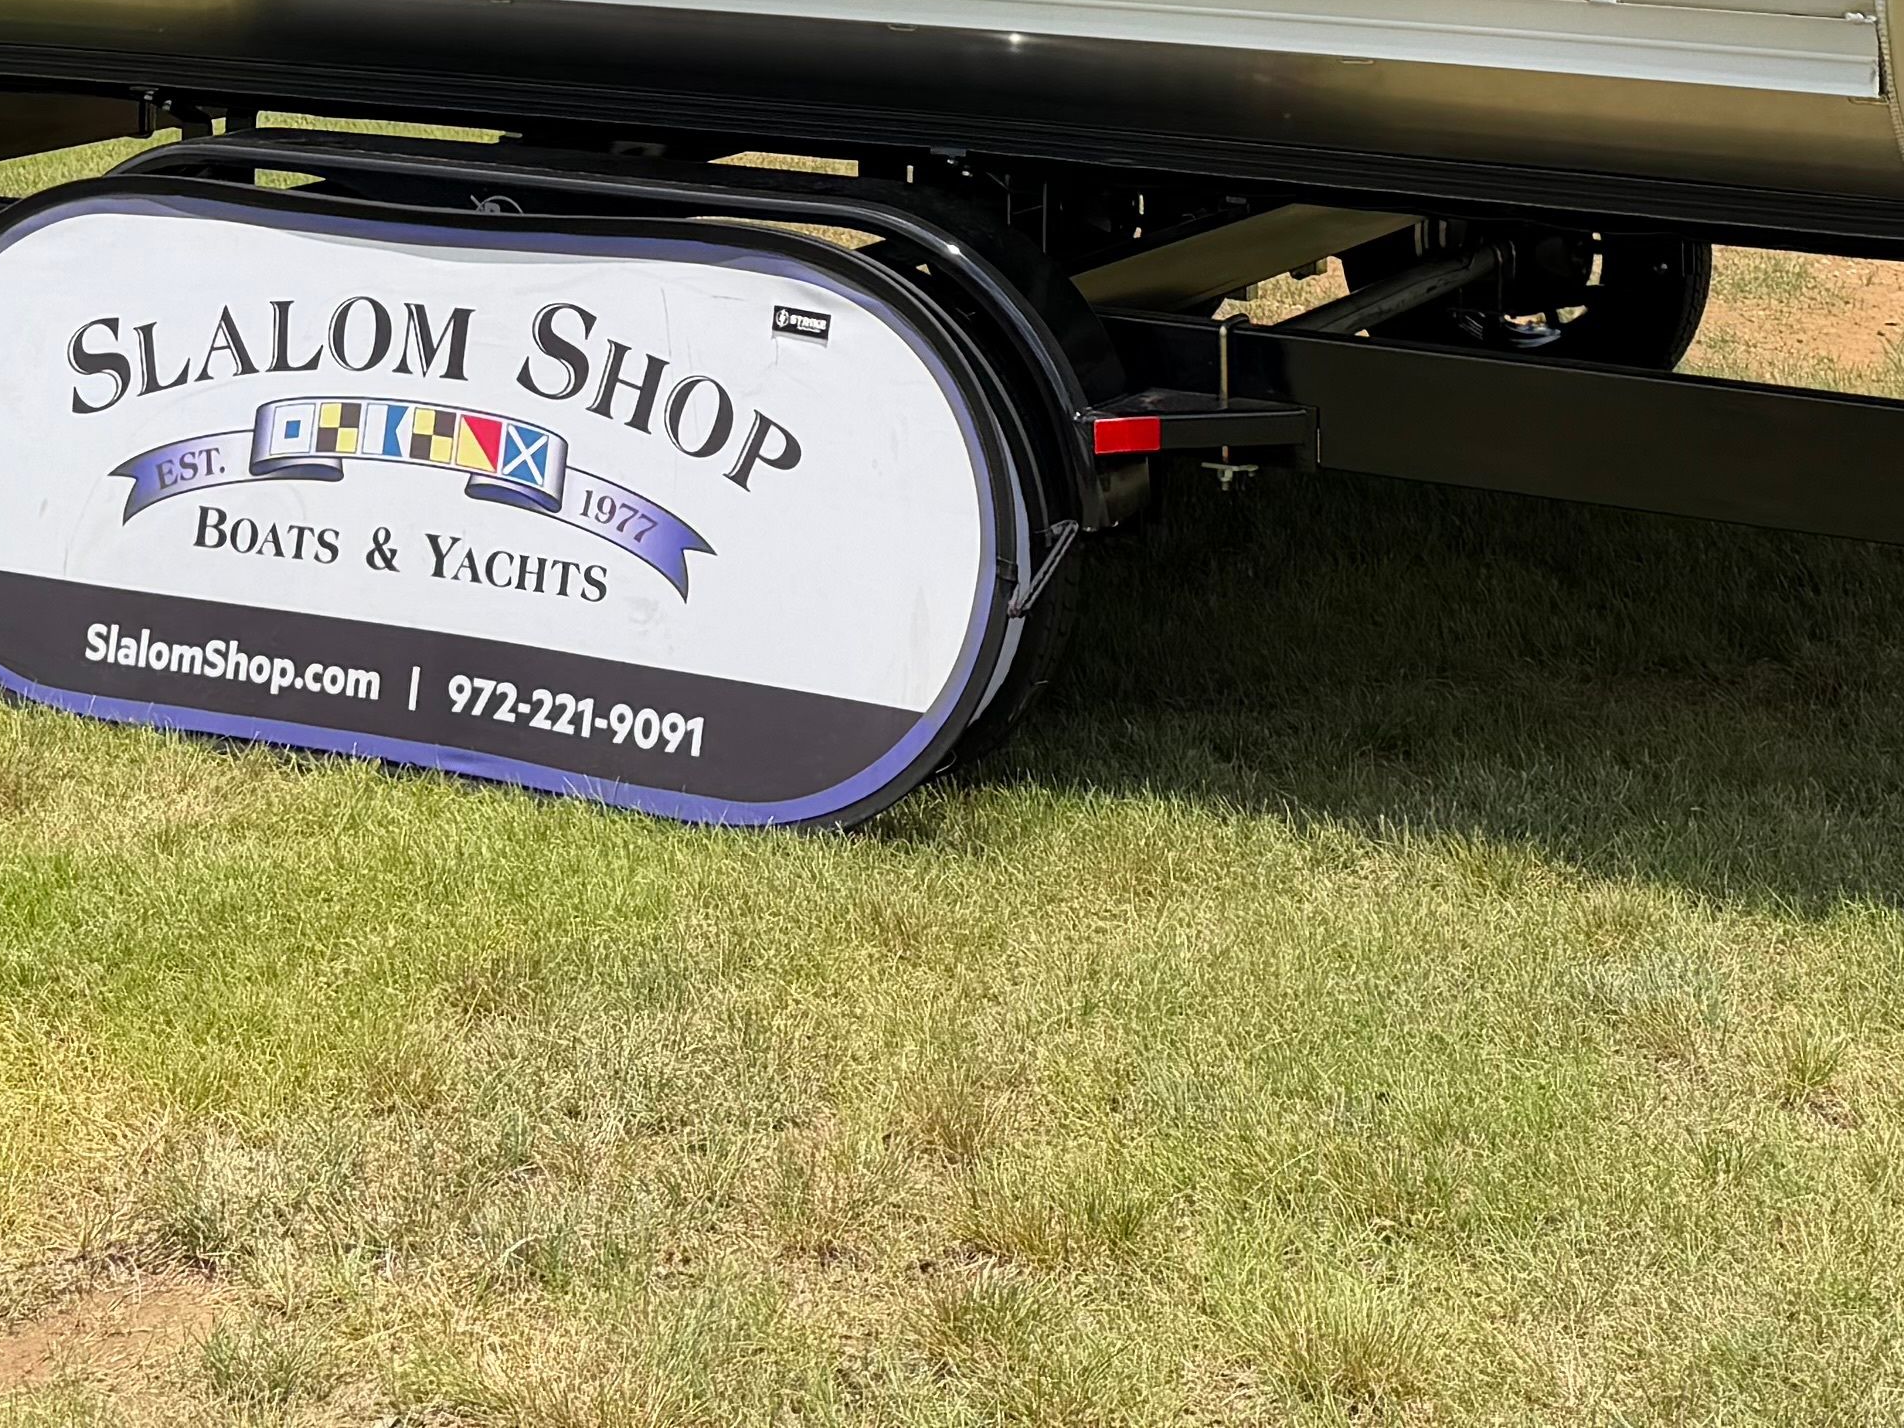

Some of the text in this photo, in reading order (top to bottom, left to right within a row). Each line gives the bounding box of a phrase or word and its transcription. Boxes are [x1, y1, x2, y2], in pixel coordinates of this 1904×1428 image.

[67, 295, 802, 493] SLALOM SHOP
[155, 447, 658, 543] EST. 1977
[193, 505, 608, 602] BOATS & YACHTS
[85, 623, 381, 700] SlalomShop.com
[448, 674, 704, 757] 972-221-9091
